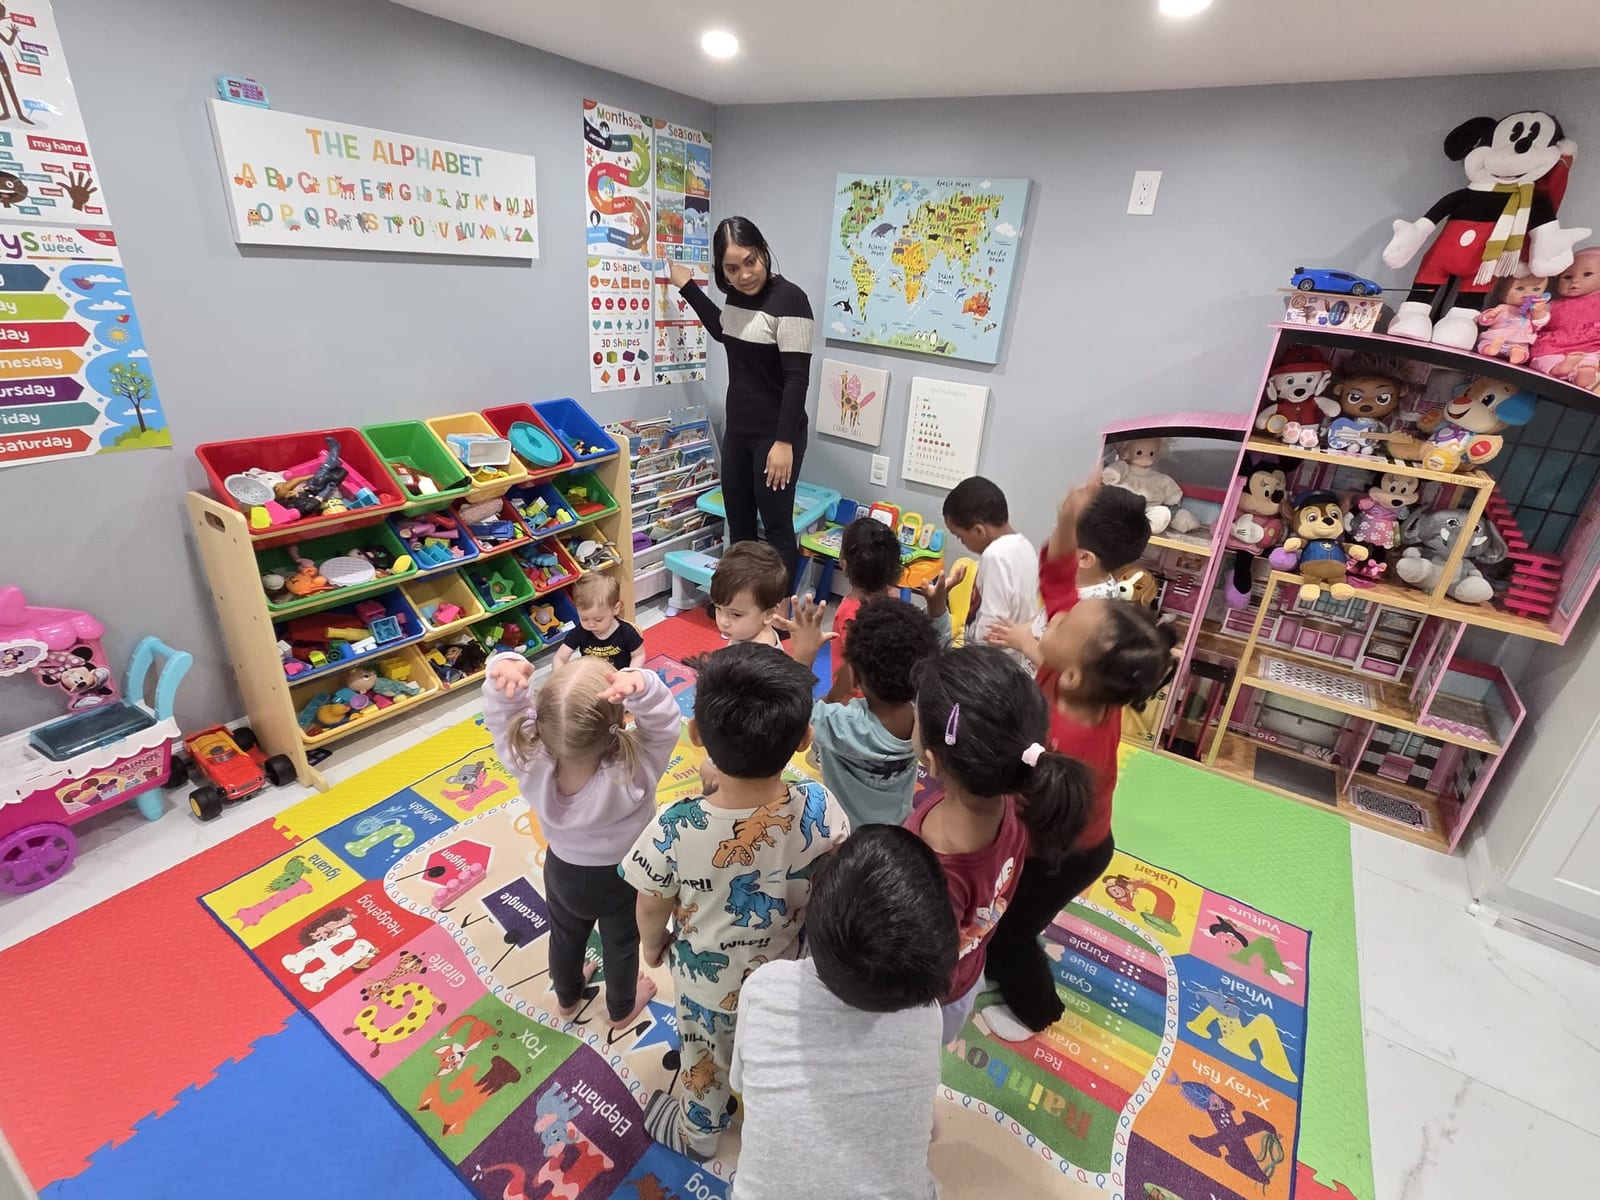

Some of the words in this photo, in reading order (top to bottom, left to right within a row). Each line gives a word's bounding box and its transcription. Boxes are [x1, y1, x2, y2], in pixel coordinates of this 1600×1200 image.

[597, 106, 633, 128] Months
[32, 140, 51, 151] my
[52, 140, 82, 153] hand
[668, 124, 702, 143] Seasons
[305, 128, 360, 160] THE
[372, 139, 483, 177] ALPHABET
[242, 163, 257, 185] A
[297, 171, 314, 194] C
[327, 176, 341, 196] D
[360, 178, 373, 201] E
[399, 183, 412, 201] G
[459, 192, 470, 209] J
[475, 194, 487, 211] K
[506, 197, 519, 215] M
[256, 202, 273, 223] O
[280, 204, 294, 223] P
[304, 207, 320, 229] Q
[324, 208, 338, 226] R
[367, 213, 379, 232] S
[384, 216, 395, 234] T
[413, 220, 425, 237] U
[438, 222, 449, 238] V
[459, 221, 476, 239] W
[480, 224, 490, 240] X
[500, 226, 509, 242] Y
[514, 227, 523, 242] Z
[0, 231, 40, 259] ys
[41, 234, 52, 243] of
[56, 234, 73, 243] the
[42, 242, 85, 254] week
[601, 261, 611, 272] 2D
[613, 262, 641, 274] Shapes
[601, 338, 611, 348] 3D
[613, 337, 641, 349] Shapes
[409, 801, 444, 826] Jellyfish
[308, 854, 342, 882] Iguana
[440, 849, 471, 873] olygon
[681, 878, 714, 893] AR!!
[1134, 863, 1179, 889] Uakari
[356, 894, 405, 938] Hedgehog
[500, 892, 547, 929] Rectangle
[1228, 904, 1282, 935] Vulture
[1081, 925, 1109, 944] Pink
[1069, 936, 1110, 963] Purple
[428, 953, 467, 988] Giraffe
[1069, 954, 1098, 976] Blue
[1060, 971, 1093, 994] Cyan
[1221, 975, 1274, 1010] Whale
[1058, 989, 1091, 1013] Gree
[517, 1029, 548, 1060] Fox
[1048, 1029, 1081, 1056] Oran
[1033, 1047, 1063, 1072] Red
[1191, 1059, 1221, 1088] fish
[1226, 1074, 1271, 1111] X-ray
[570, 1079, 634, 1138] Elephant
